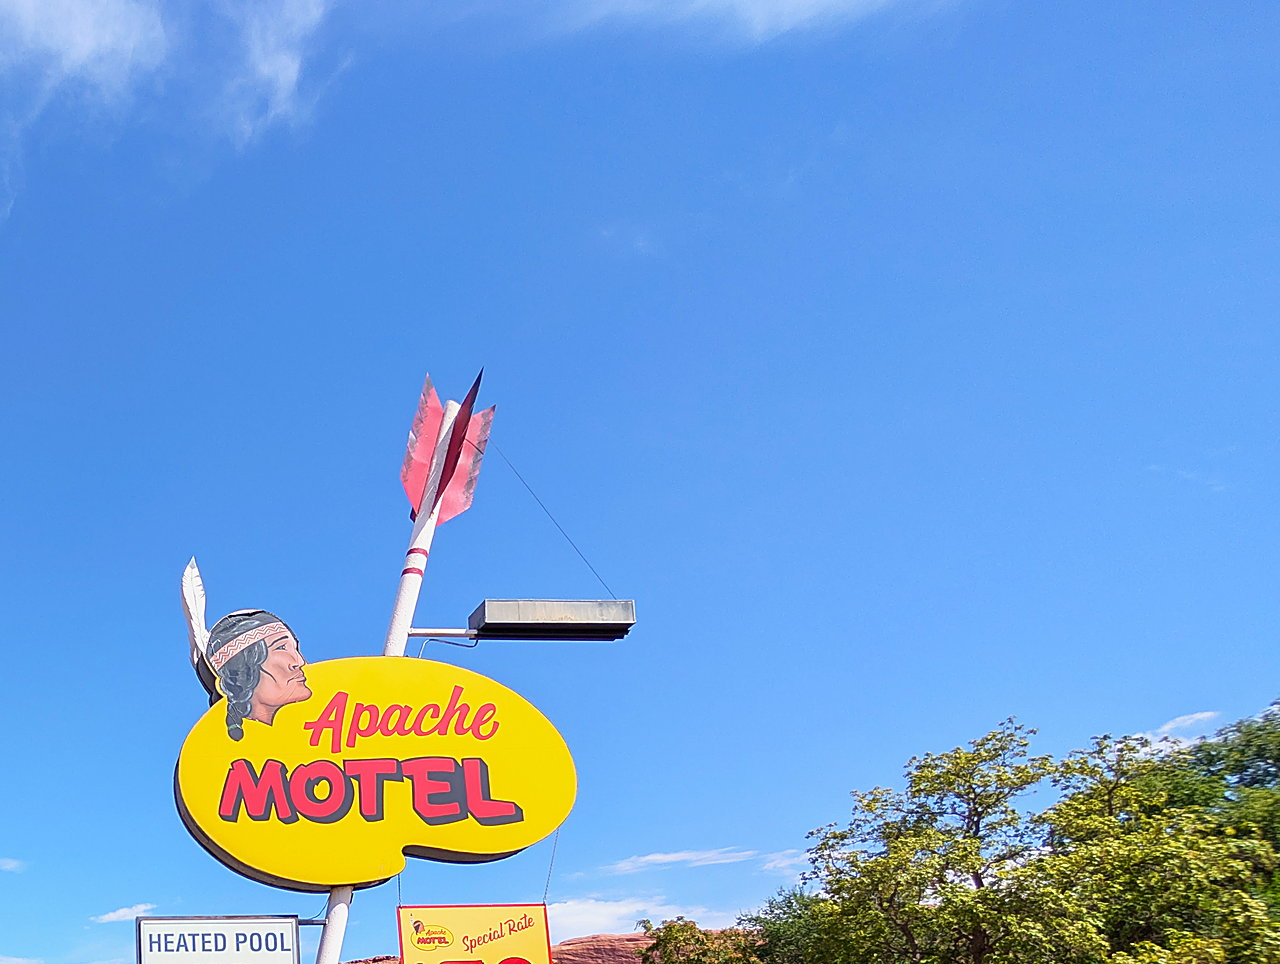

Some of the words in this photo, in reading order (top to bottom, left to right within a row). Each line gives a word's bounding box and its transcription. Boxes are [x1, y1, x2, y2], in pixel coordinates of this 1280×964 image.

[304, 685, 500, 753] Apache
[218, 756, 524, 827] MOTEL
[149, 933, 227, 953] HEATED
[235, 932, 291, 952] POOL
[417, 936, 450, 944] MOTEL
[425, 928, 447, 936] Apache
[462, 922, 506, 953] Special
[504, 913, 535, 937] Rate
